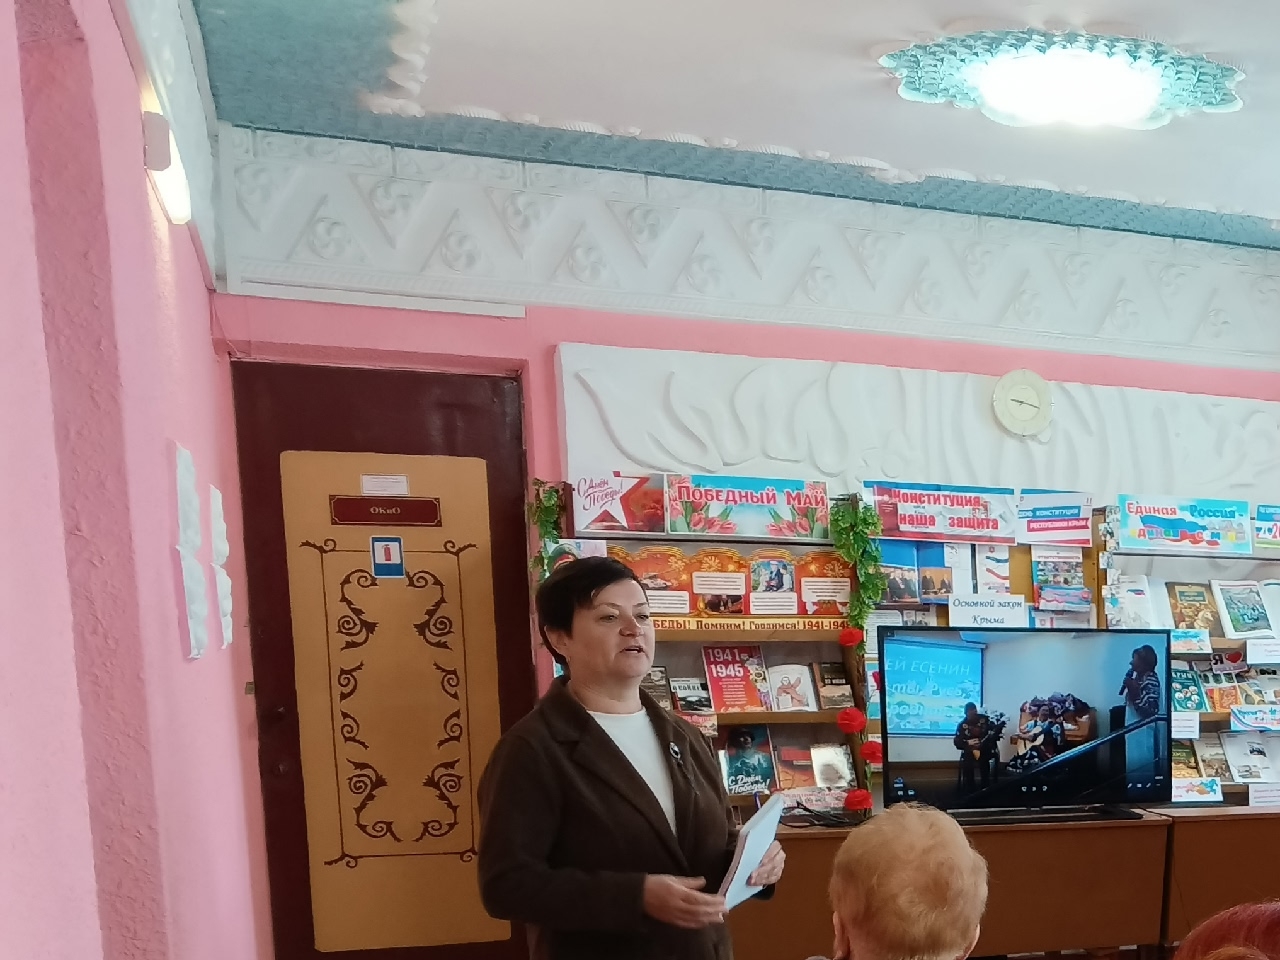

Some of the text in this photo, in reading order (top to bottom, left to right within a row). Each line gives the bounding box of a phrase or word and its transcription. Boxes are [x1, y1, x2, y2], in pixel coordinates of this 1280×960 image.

[677, 484, 826, 508] ПОБЕДНЫЙ МАЙ
[1127, 502, 1177, 517] Единая
[1189, 504, 1236, 518] Россия
[948, 516, 999, 530] защита
[953, 598, 1022, 609] Основной закон
[652, 619, 691, 630] БЕДЫ!
[972, 615, 1005, 625] Крыма
[710, 663, 744, 678] 1945
[911, 660, 970, 675] ЕСЕНИН
